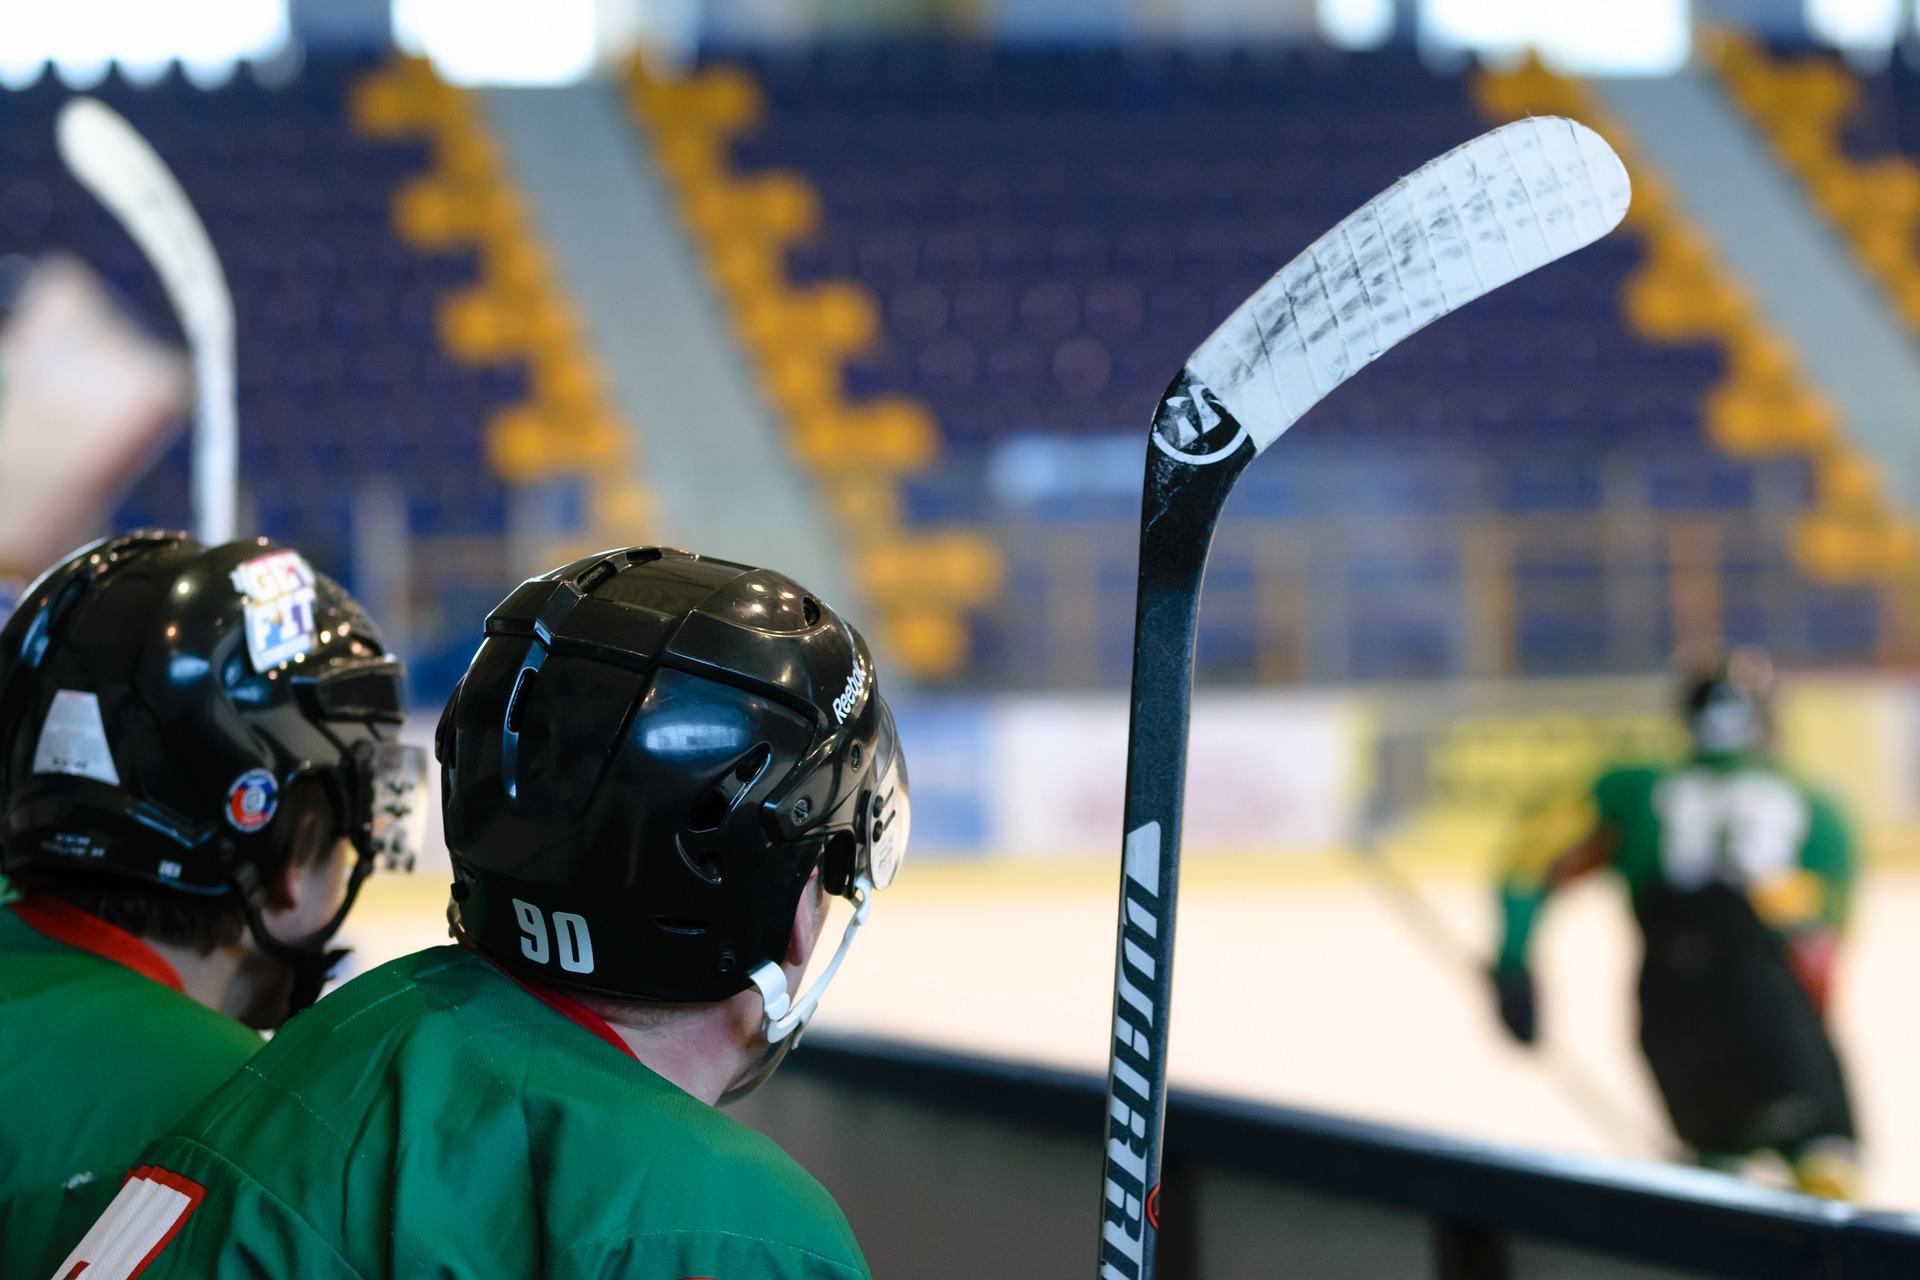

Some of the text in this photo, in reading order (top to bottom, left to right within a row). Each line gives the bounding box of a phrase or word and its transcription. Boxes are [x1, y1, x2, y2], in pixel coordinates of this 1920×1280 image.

[832, 660, 867, 725] Reebok
[512, 898, 595, 974] 90
[1101, 872, 1160, 1280] WARRI
